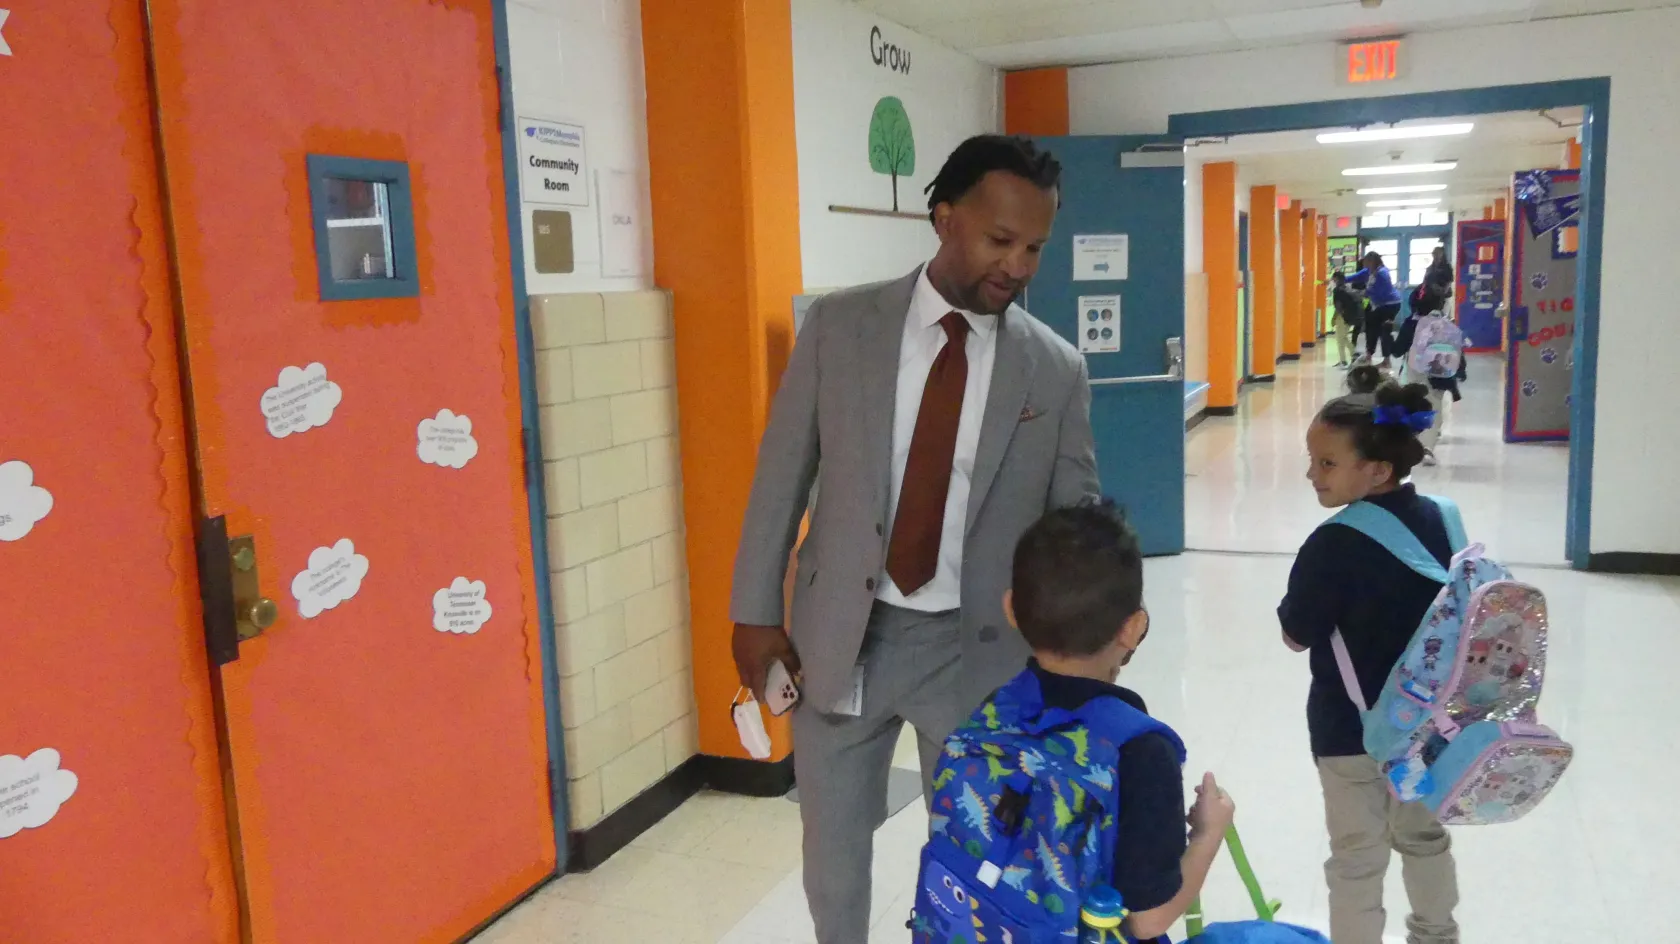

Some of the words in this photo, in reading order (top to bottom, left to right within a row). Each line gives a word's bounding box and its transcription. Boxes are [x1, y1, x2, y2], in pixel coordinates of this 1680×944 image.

[870, 25, 911, 76] Grow
[1347, 40, 1401, 83] EXIT
[529, 155, 579, 175] Community
[544, 178, 570, 192] Room
